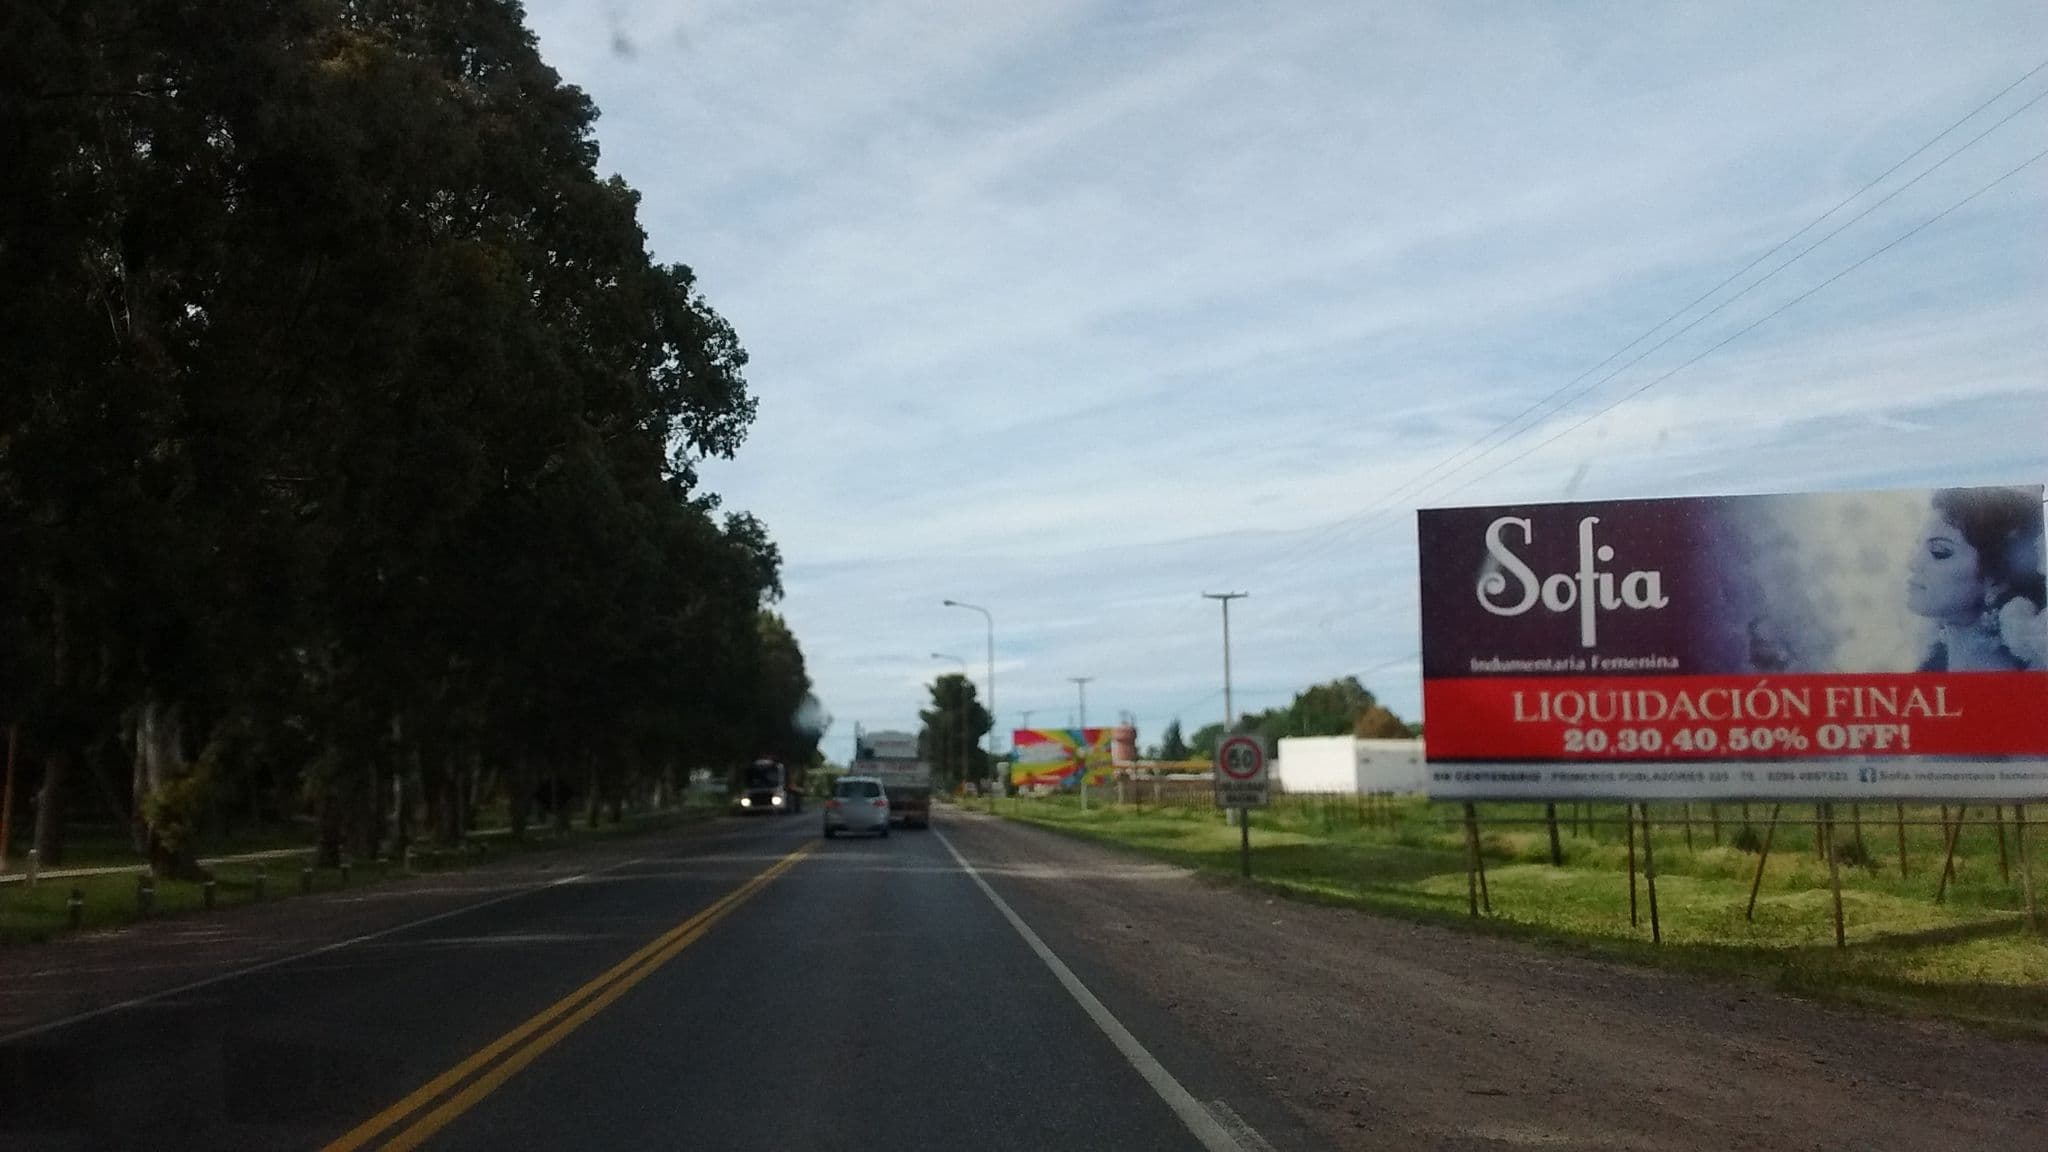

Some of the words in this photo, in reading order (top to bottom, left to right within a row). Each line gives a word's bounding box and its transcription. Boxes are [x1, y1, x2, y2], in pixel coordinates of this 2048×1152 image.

[1477, 516, 1670, 648] Sofia
[1470, 655, 1587, 673] Indumentaria
[1591, 653, 1681, 671] Femenina
[1512, 680, 1811, 725] LIQUIDACIÓN
[1824, 686, 1964, 718] FINAL
[1815, 723, 1911, 750] OFF!
